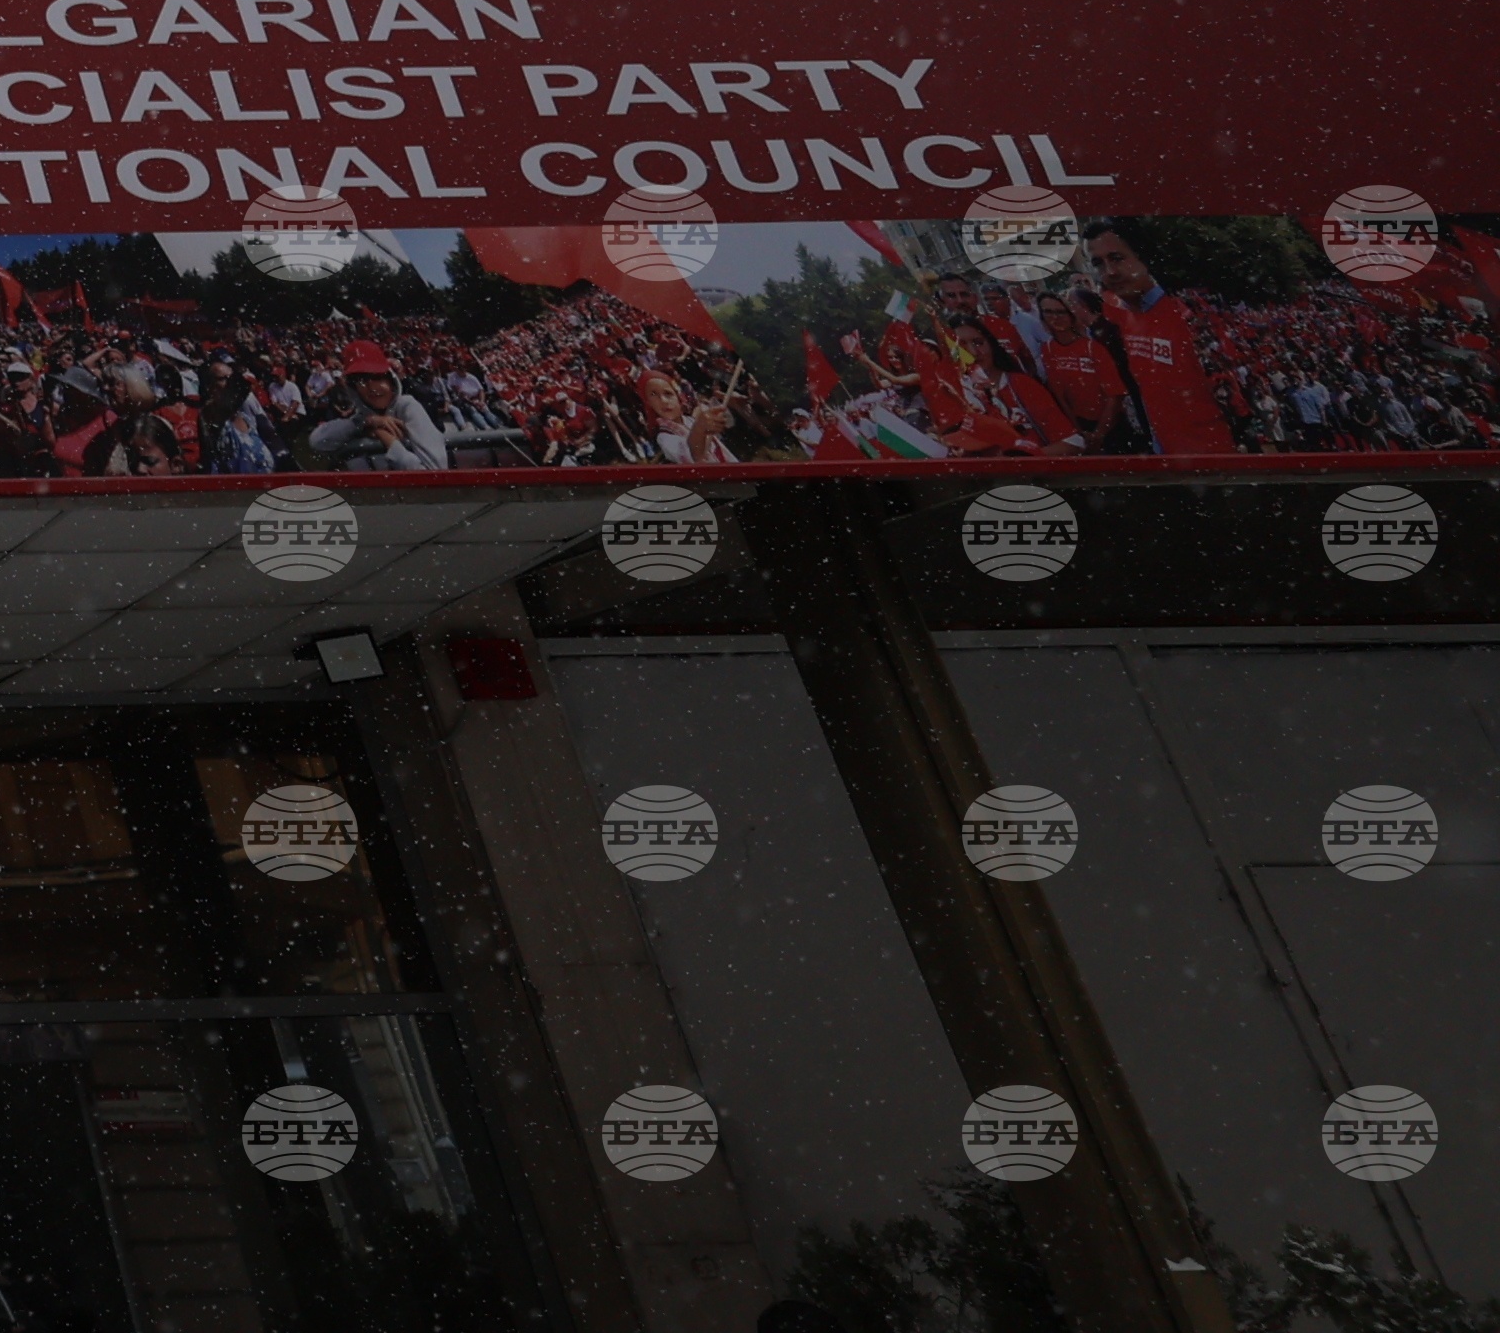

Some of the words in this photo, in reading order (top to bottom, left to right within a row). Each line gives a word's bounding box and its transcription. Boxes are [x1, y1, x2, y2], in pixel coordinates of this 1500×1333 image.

[522, 58, 934, 117] PARTY
[520, 133, 1116, 197] COUNCIL
[1154, 343, 1170, 359] 28
